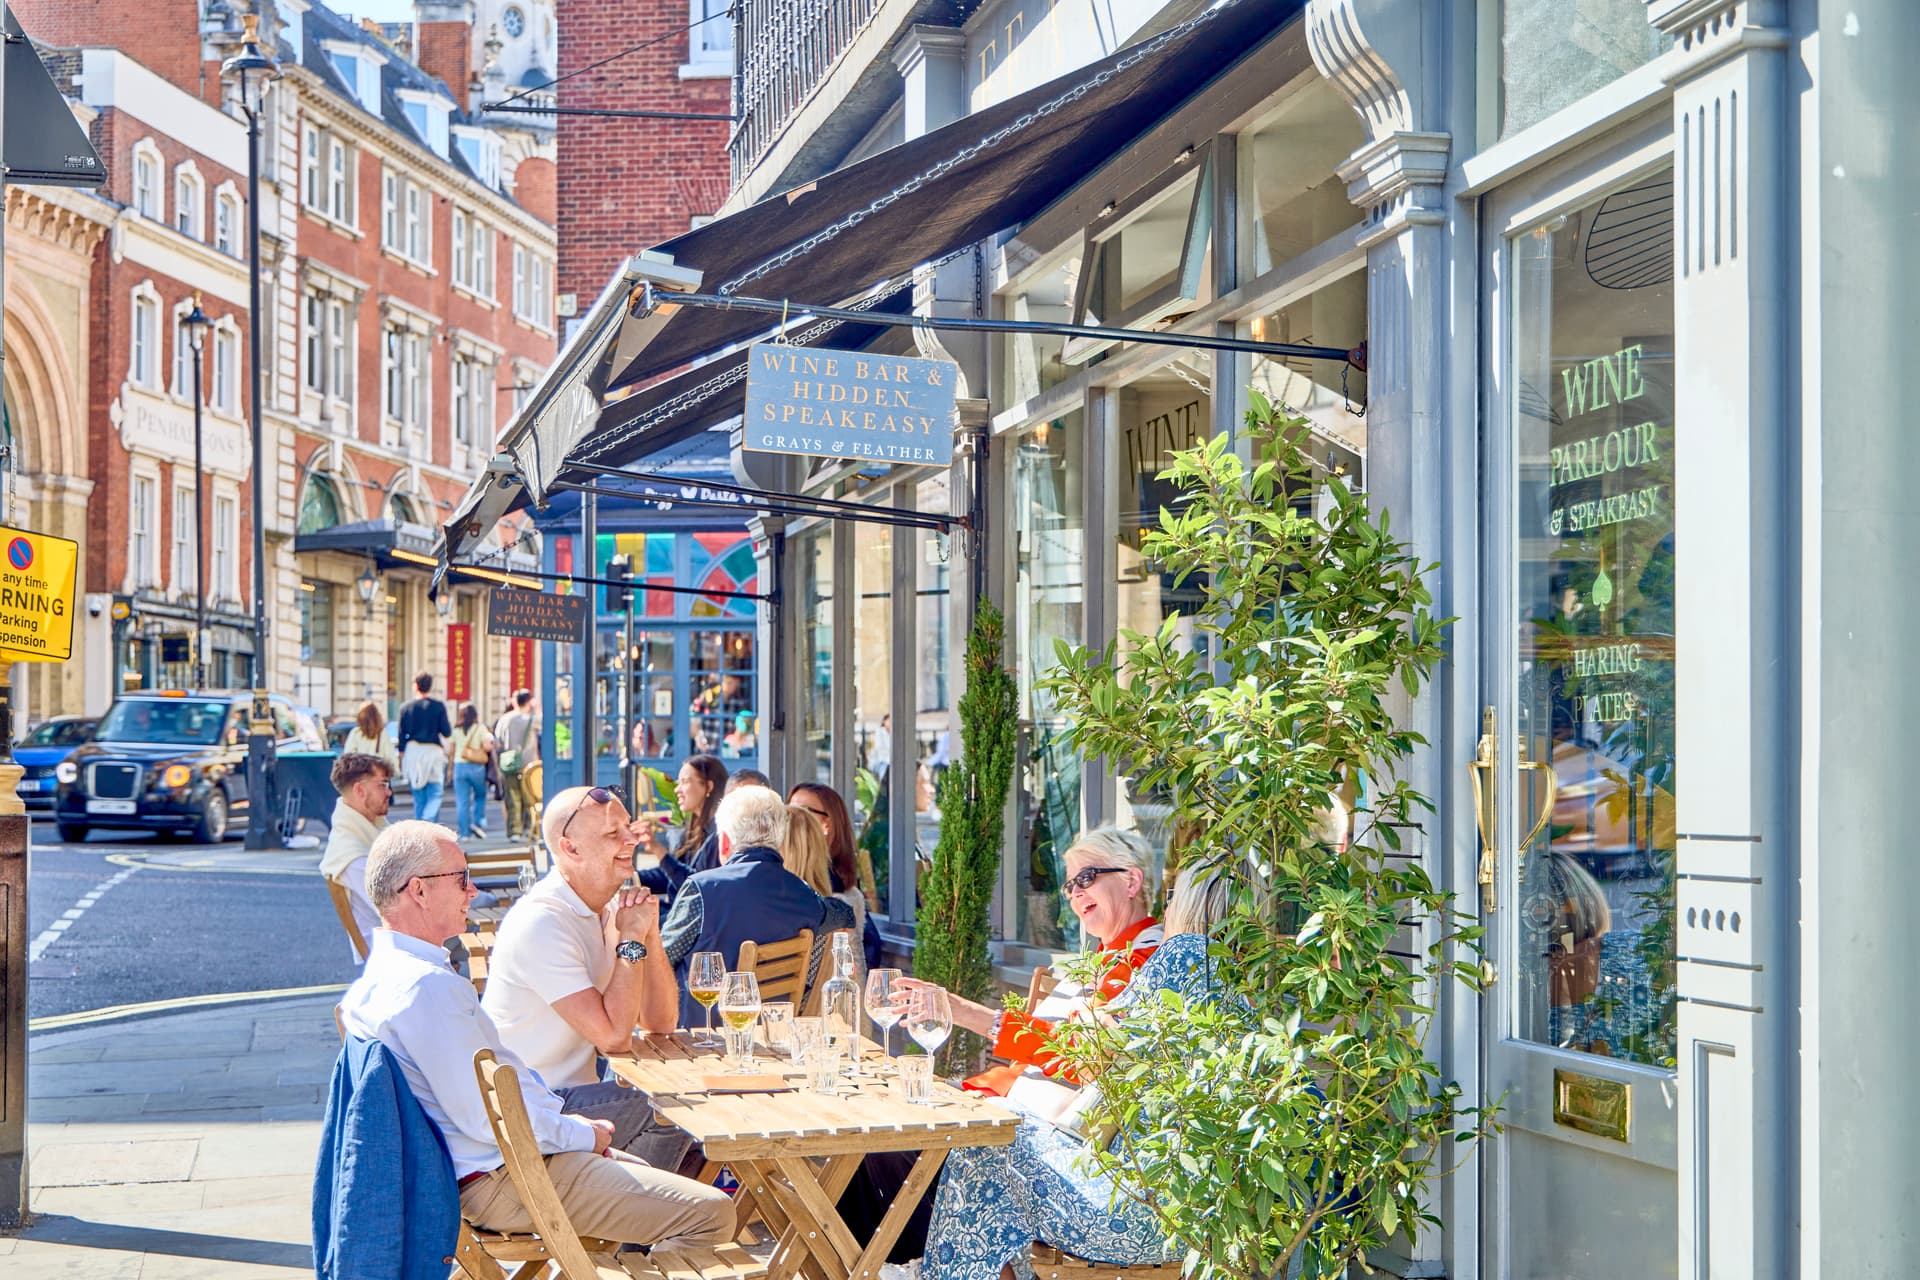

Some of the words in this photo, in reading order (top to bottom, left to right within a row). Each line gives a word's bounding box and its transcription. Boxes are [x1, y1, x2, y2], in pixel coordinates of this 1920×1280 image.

[763, 352, 839, 377] WINE
[856, 361, 911, 383] BAR
[927, 369, 943, 387] &
[1562, 344, 1644, 419] WINE
[793, 381, 911, 408] HIDDEN
[763, 404, 936, 435] SPEAKEASY
[763, 435, 822, 451] GRAYS
[831, 441, 844, 452] &
[853, 442, 935, 461] FEATHER
[1125, 400, 1200, 492] WINE
[1550, 421, 1659, 487] PARLOUR
[1550, 508, 1563, 536] &
[1570, 486, 1659, 533] SPEAKEASY
[3, 573, 22, 587] any
[25, 575, 48, 589] time
[2, 588, 64, 616] RNING
[496, 591, 529, 603] WINE
[539, 595, 564, 606] BAR
[509, 604, 564, 617] HIDDEN
[494, 628, 523, 636] GRAYS
[496, 614, 574, 630] SPEAKEASY
[1574, 692, 1633, 723] PLATES
